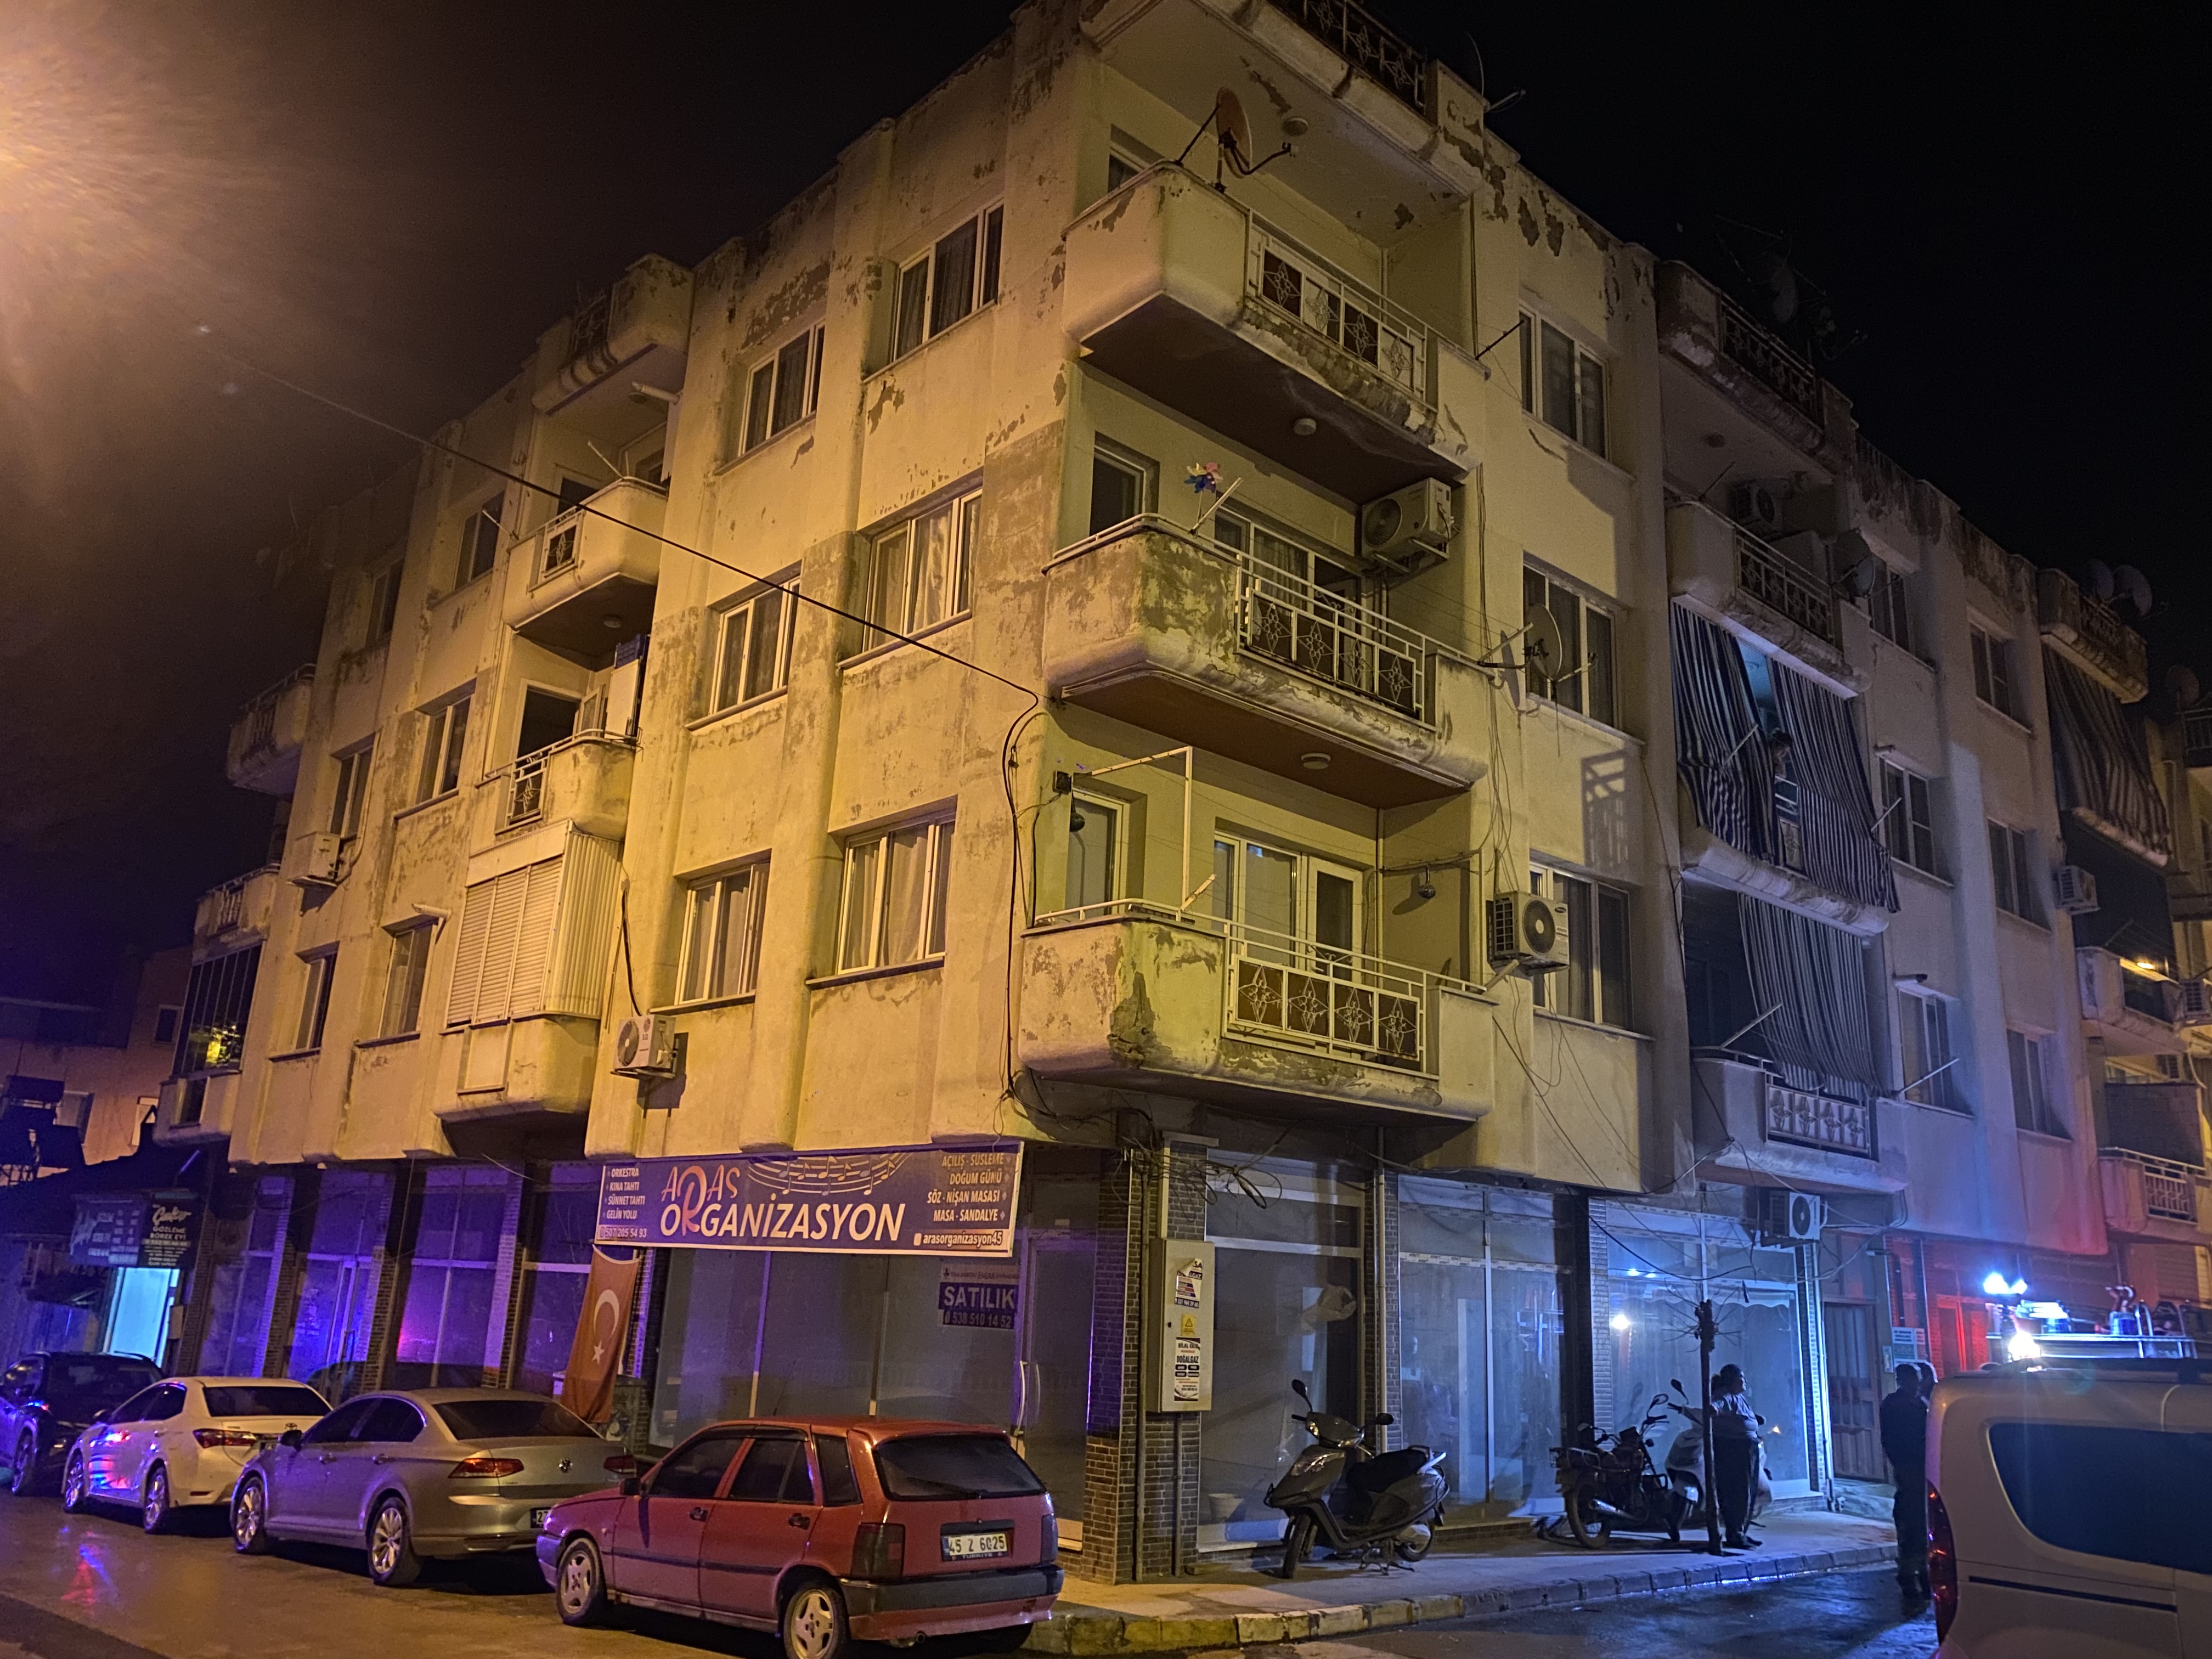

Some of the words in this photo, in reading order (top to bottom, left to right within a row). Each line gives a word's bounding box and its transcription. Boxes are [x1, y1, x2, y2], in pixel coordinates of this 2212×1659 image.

[941, 1154, 966, 1170] AÇILIŞ
[611, 1167, 639, 1178] ORKESTRA
[949, 1170, 978, 1185] DOĞUM
[980, 1168, 1003, 1184] GÜNÜ
[610, 1182, 623, 1191] KINA
[624, 1181, 640, 1190] TAHTI
[607, 1193, 629, 1205] SÜNNET
[629, 1195, 646, 1205] TAHTI
[927, 1188, 942, 1204] SÖZ
[946, 1187, 970, 1206] NİŞAN
[970, 1190, 1000, 1203] MASASI
[606, 1207, 622, 1219] GELİN
[623, 1210, 637, 1220] YOLU
[933, 1209, 955, 1221] MASA
[959, 1209, 998, 1221] SANDALYE
[604, 1227, 617, 1239] 507
[617, 1228, 629, 1238] 205
[629, 1228, 638, 1238] 54
[639, 1228, 647, 1238] 93
[923, 1231, 1003, 1248] arasorganizasyon45
[944, 1285, 1014, 1309] SATILIK
[944, 1311, 951, 1324] 0
[969, 1313, 985, 1327] 510
[988, 1314, 998, 1327] 14
[1000, 1316, 1012, 1329] 52
[1176, 1355, 1199, 1363] DOĞALGAZ
[950, 1539, 962, 1553] 45
[968, 1538, 974, 1552] Z
